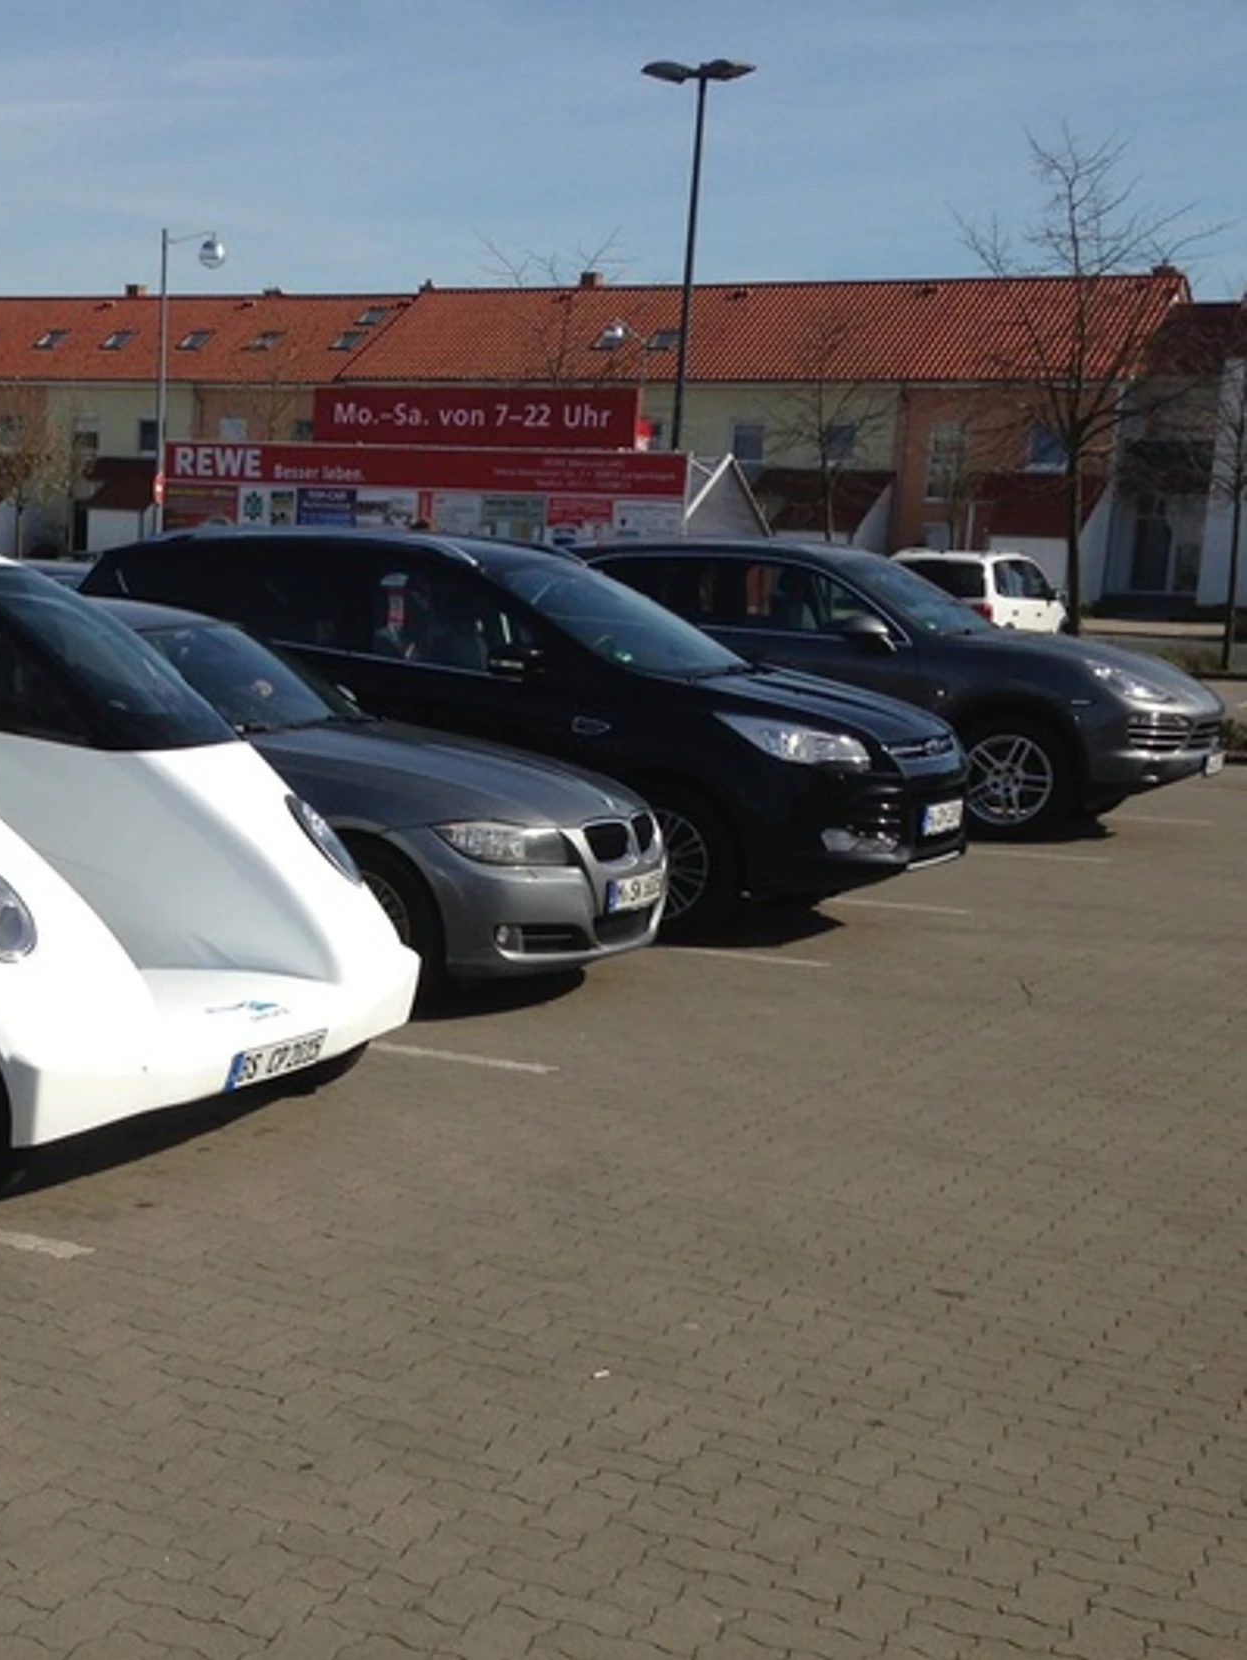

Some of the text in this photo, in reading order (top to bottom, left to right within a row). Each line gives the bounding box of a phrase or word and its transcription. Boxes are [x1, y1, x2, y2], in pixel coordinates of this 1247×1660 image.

[439, 408, 485, 426] von
[564, 403, 612, 428] Uhr
[174, 447, 366, 482] REWE Besser leben.
